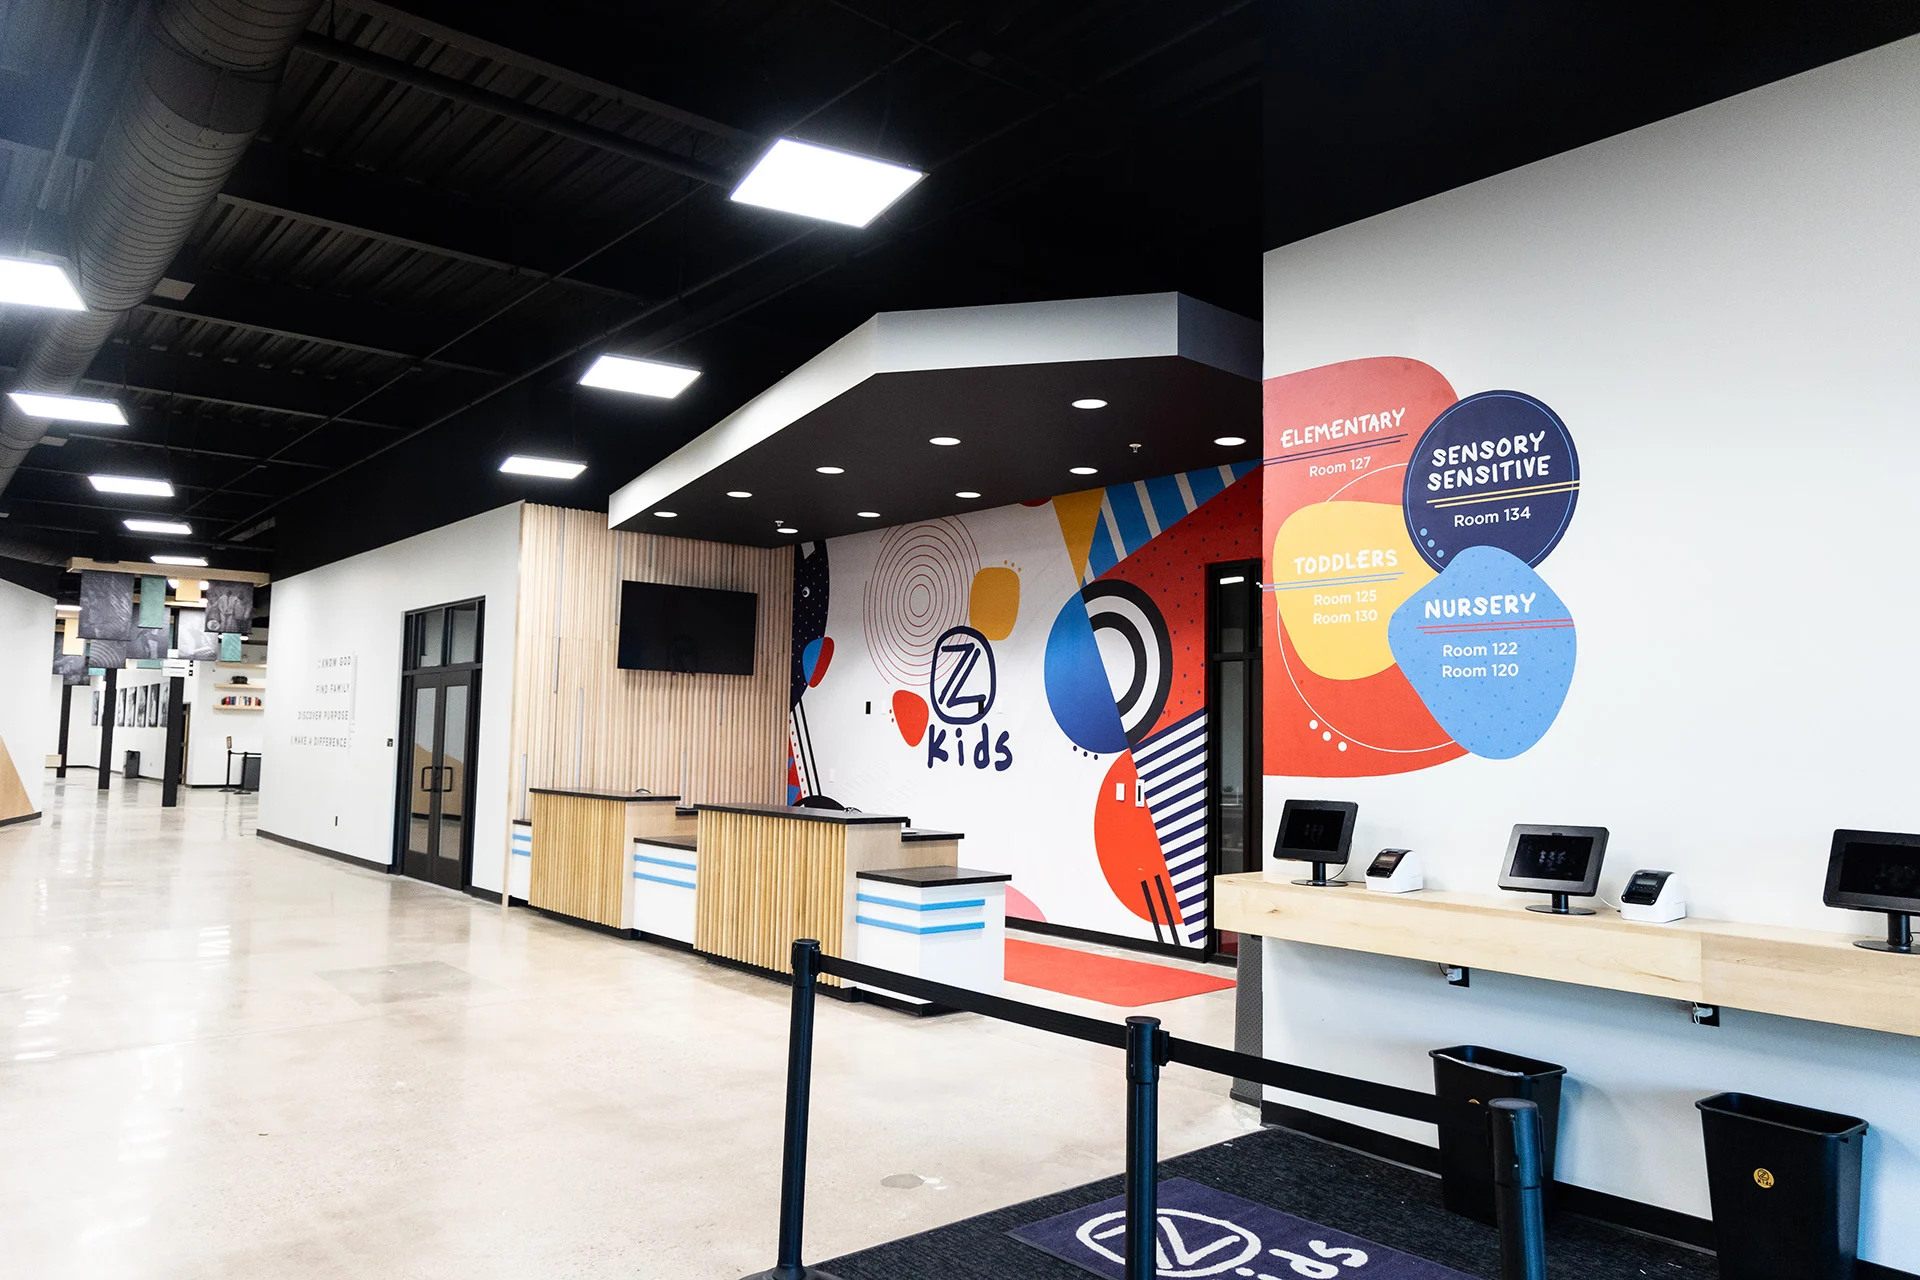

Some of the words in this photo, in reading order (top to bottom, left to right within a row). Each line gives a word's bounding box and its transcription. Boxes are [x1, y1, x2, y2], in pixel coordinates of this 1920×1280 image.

[1280, 406, 1406, 449] ELEMENTARY
[1431, 430, 1546, 468] SENSORY
[1309, 463, 1347, 478] Room
[1349, 456, 1372, 472] 127
[1427, 454, 1551, 492] SENSITIVE
[1453, 513, 1499, 528] Room
[1503, 505, 1531, 522] 134
[1293, 549, 1398, 575] TODDLERS
[1313, 593, 1352, 606] Room
[1355, 589, 1377, 603] 125
[1424, 592, 1536, 619] NURSERY
[1313, 612, 1352, 625] Room
[1355, 609, 1378, 622] 130
[1442, 644, 1487, 657] Room
[1491, 642, 1518, 655] 122
[1442, 665, 1487, 678] Room
[1491, 663, 1519, 677] 120
